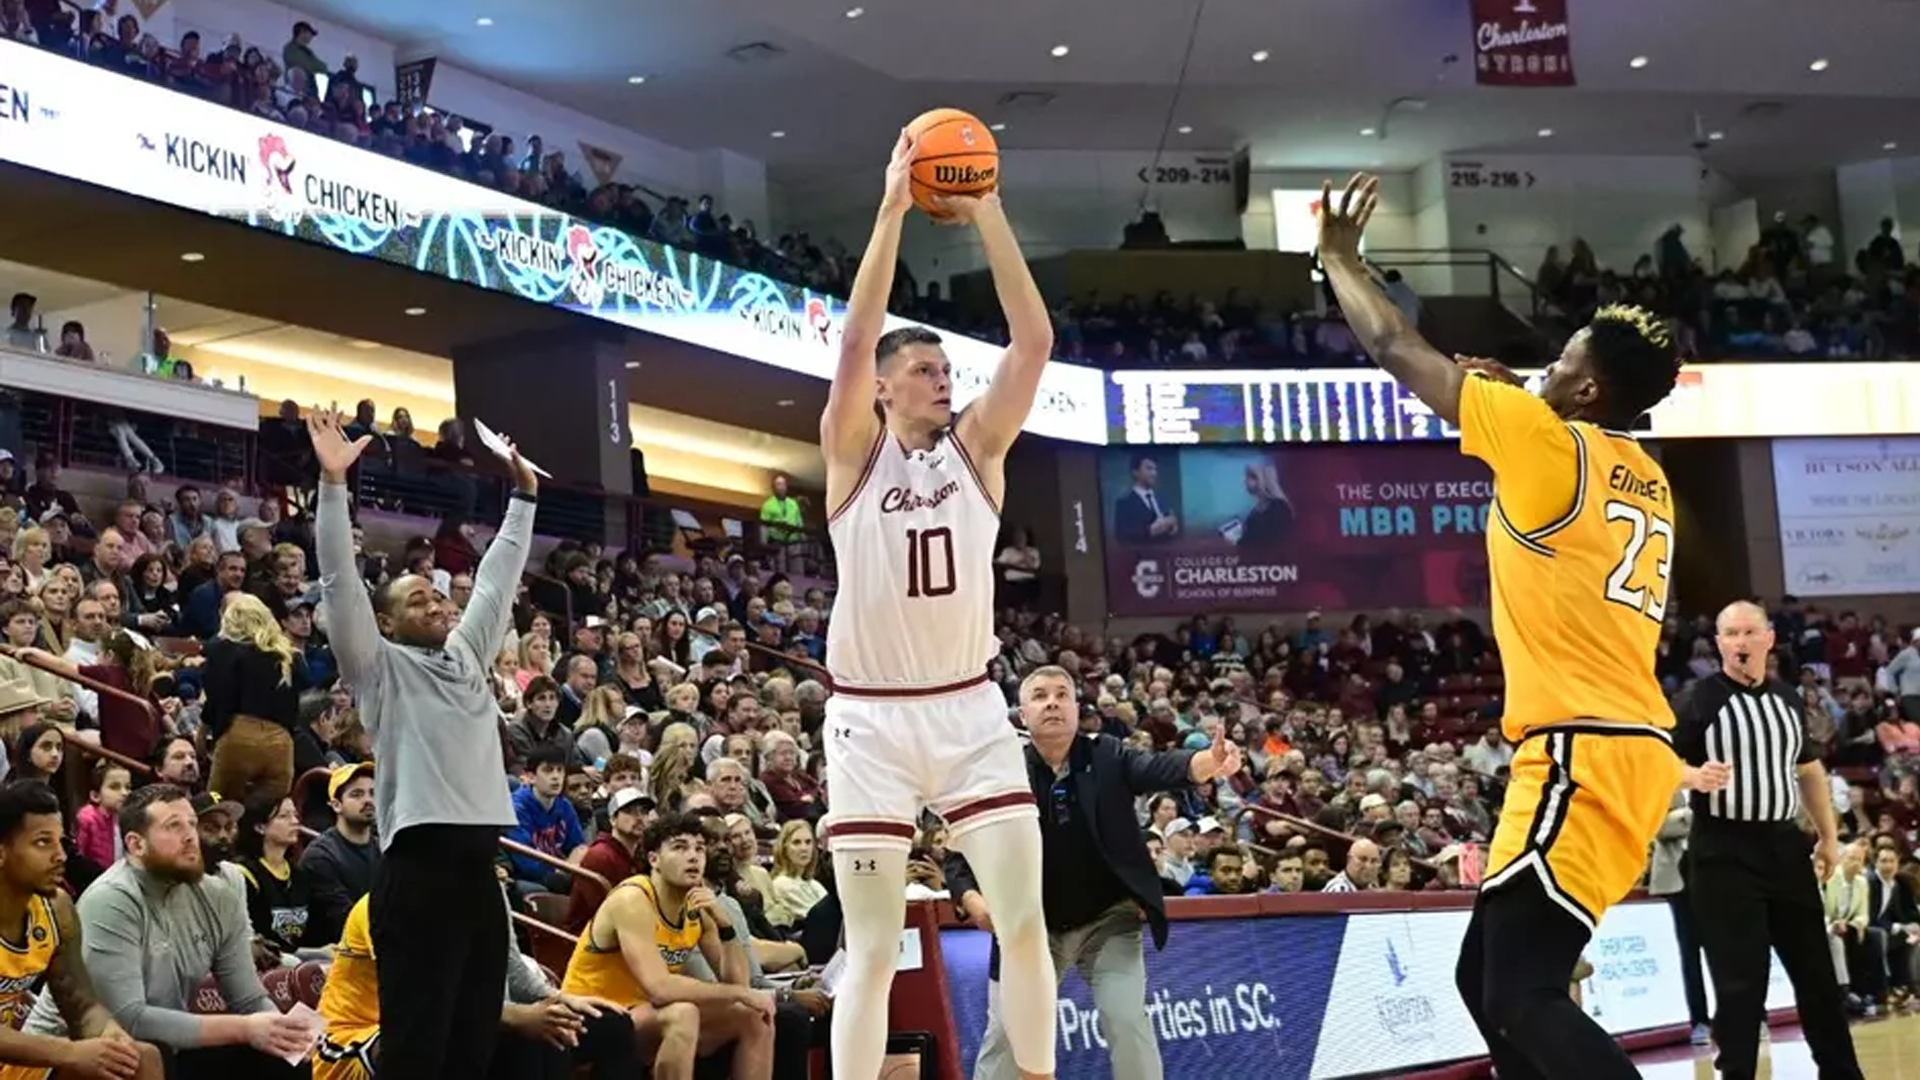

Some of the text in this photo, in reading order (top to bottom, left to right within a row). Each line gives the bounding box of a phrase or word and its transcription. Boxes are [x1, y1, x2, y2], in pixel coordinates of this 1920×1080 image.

[1477, 20, 1568, 51] Charleston
[935, 165, 996, 184] Wilson
[305, 173, 398, 227] CHICKEN
[1336, 483, 1373, 500] THE
[1379, 482, 1430, 500] ONLY
[1339, 504, 1416, 537] MBA
[906, 526, 957, 598] 10
[1174, 555, 1239, 568] COLLEGE OF
[1174, 565, 1299, 585] CHARLESTON
[1604, 499, 1675, 624] 23
[1206, 985, 1237, 1034] in
